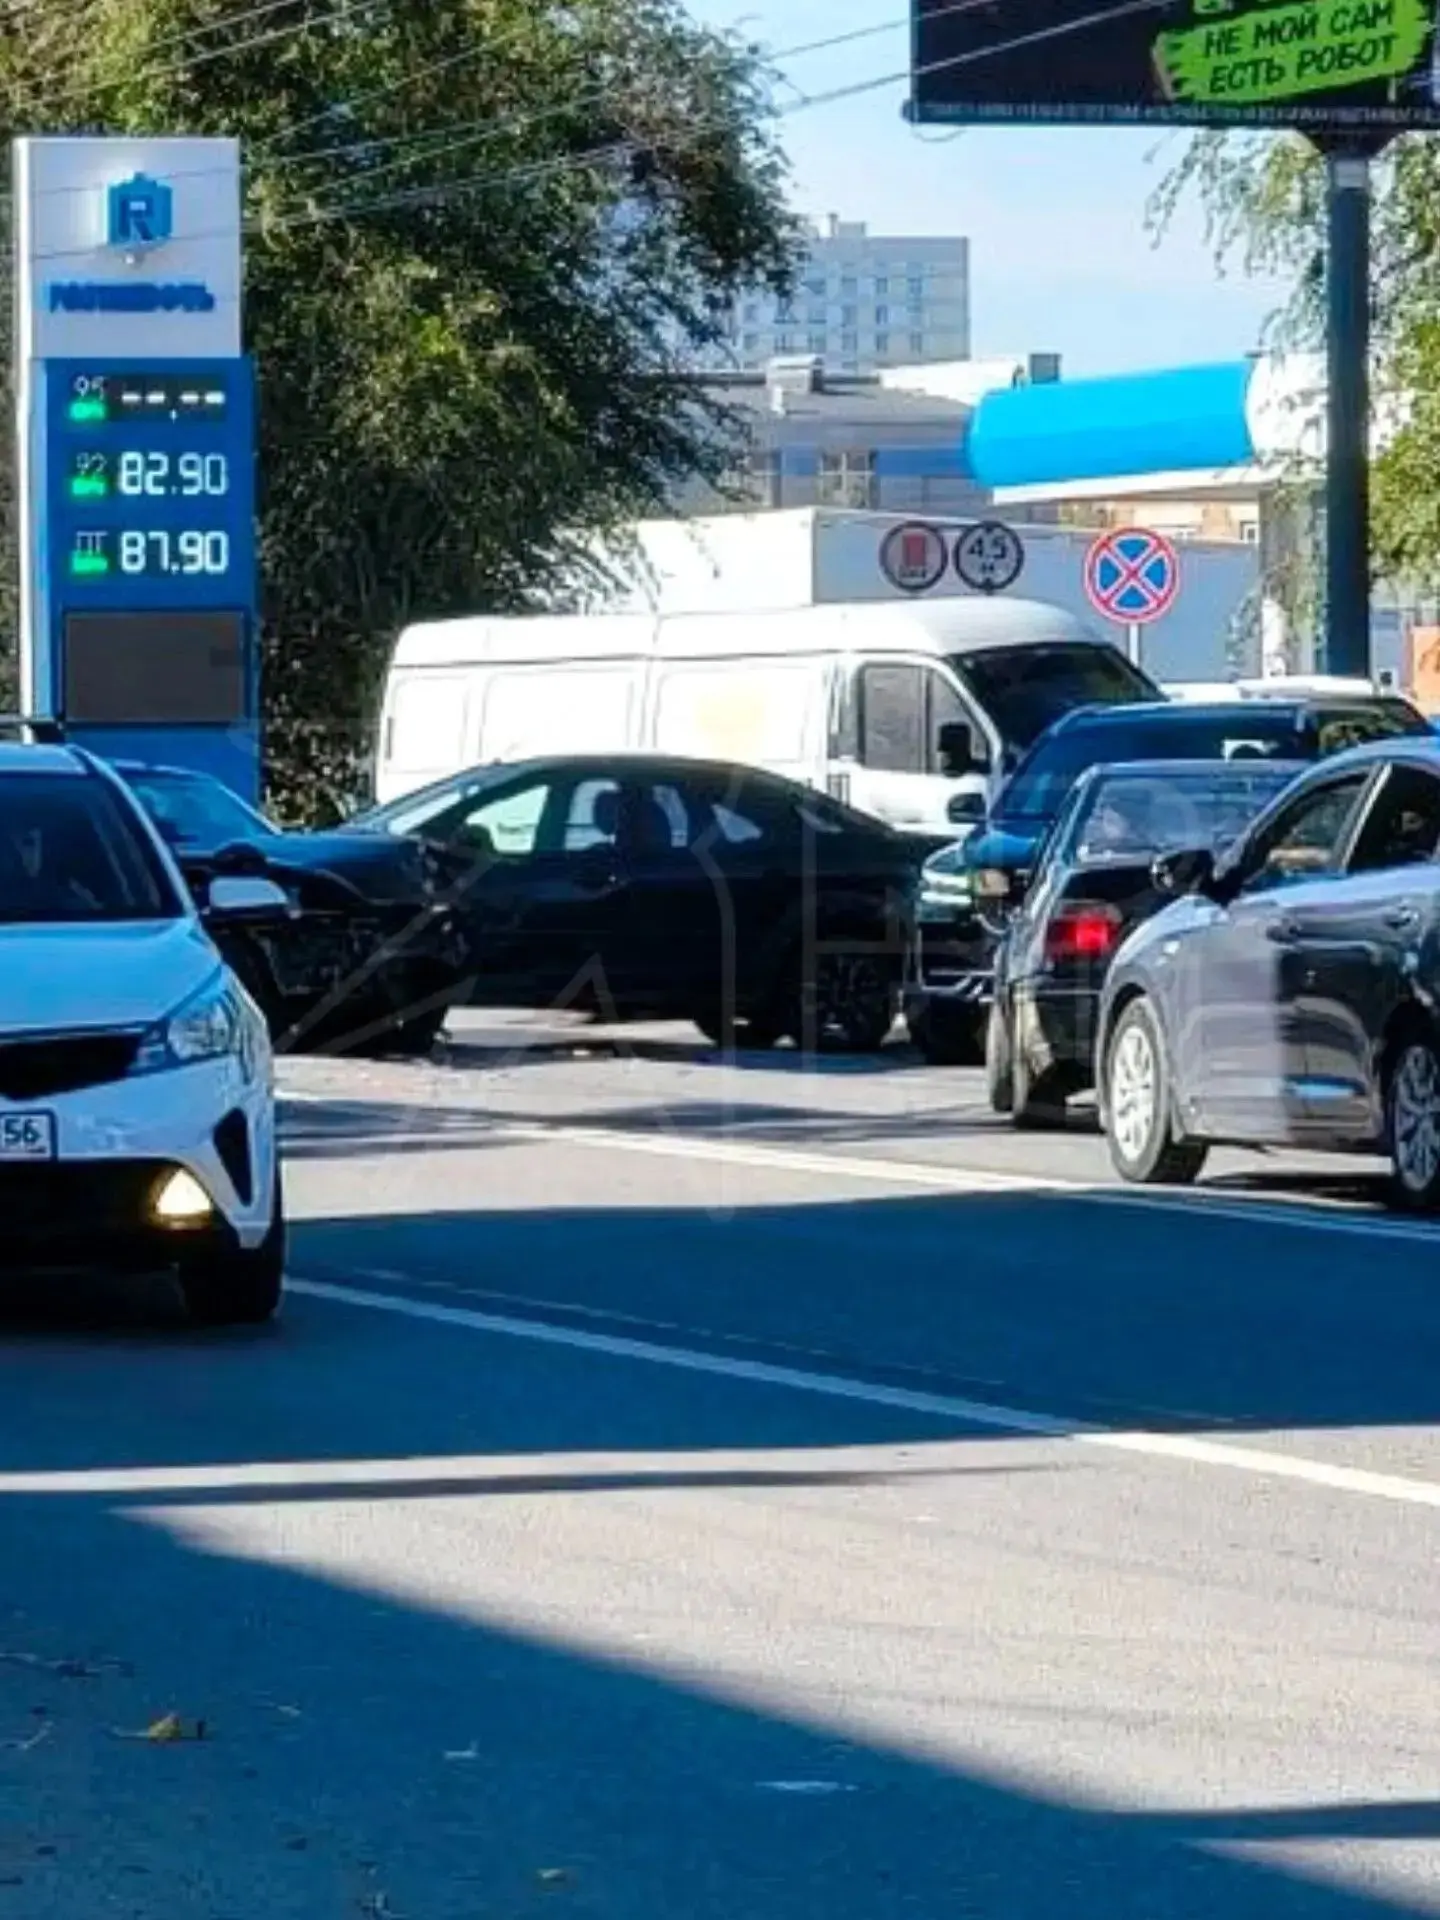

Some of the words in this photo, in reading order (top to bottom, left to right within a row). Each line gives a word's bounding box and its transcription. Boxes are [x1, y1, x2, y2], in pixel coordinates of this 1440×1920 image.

[1205, 24, 1243, 58] НЕ
[1330, 1, 1395, 36] САМ
[1209, 57, 1286, 94] ЕСТЬ
[1297, 34, 1399, 78] РОБОТ
[117, 194, 153, 241] R
[118, 451, 228, 496] 82.90
[120, 530, 229, 575] 87.90
[4, 1118, 42, 1145] 56
